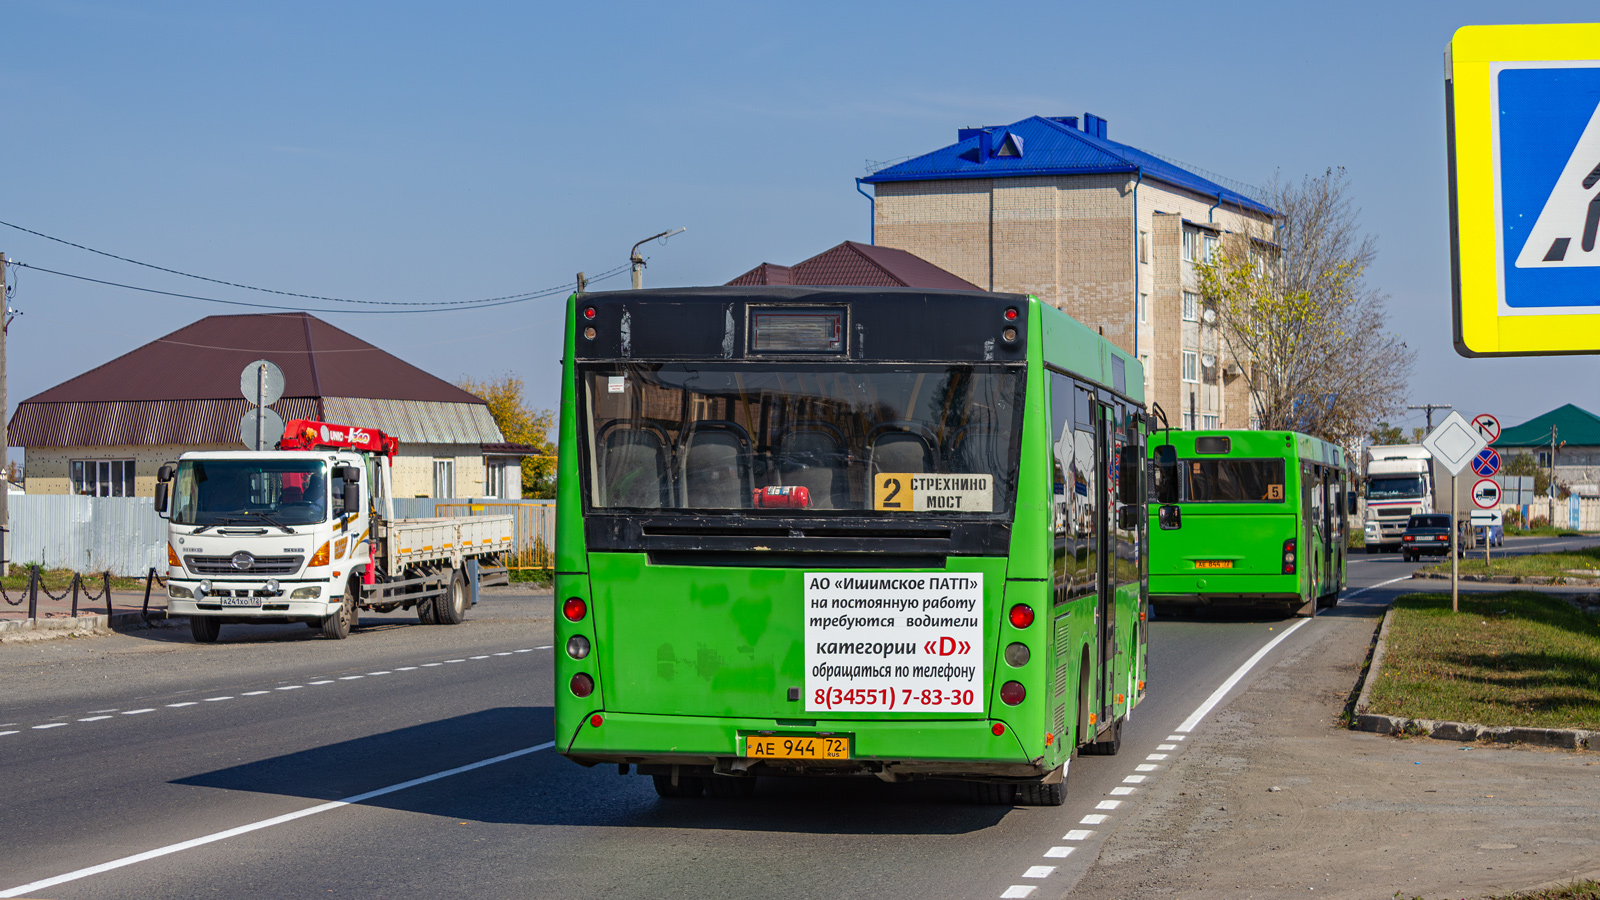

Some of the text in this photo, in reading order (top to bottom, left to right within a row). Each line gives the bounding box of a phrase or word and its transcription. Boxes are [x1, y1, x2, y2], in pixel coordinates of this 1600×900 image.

[910, 478, 987, 491] СТРЕХНИНО
[1271, 486, 1279, 498] 5
[883, 478, 901, 508] 2
[926, 496, 962, 508] МОСТ
[809, 577, 978, 590] АО «Ишимское ПАТП»
[811, 596, 977, 612] на постоянную работу
[809, 614, 978, 630] требуются водители
[816, 636, 971, 659] категории «D»
[812, 662, 976, 682] обращаться по телефону
[814, 686, 974, 710] 8(34551) 7-83-30
[783, 739, 815, 756] 944
[825, 739, 842, 753] 72
